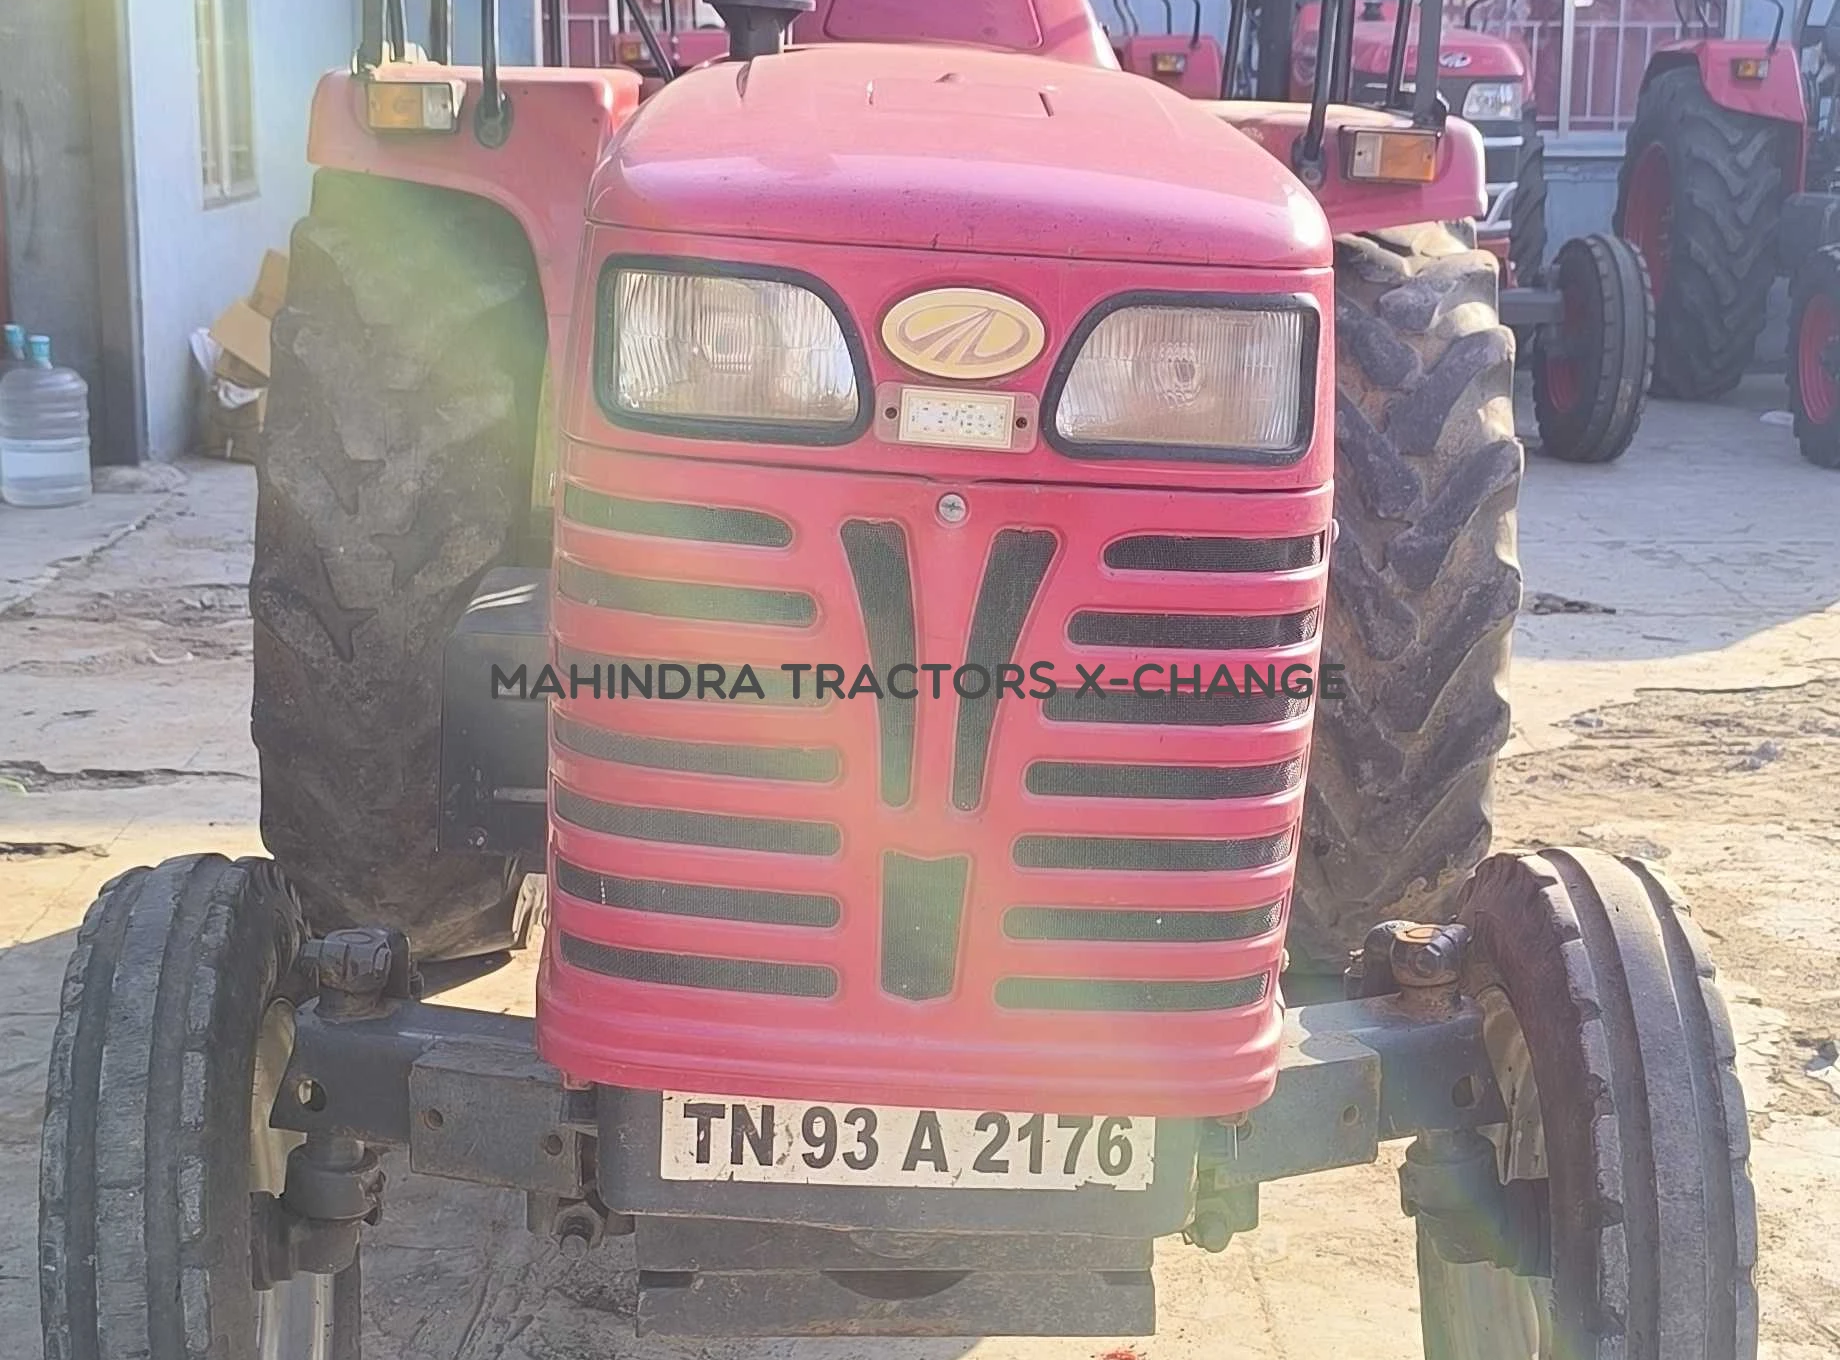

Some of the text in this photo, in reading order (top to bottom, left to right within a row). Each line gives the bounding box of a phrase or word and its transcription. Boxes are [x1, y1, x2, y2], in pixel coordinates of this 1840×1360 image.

[683, 1103, 1134, 1177] TN 93 A 2176
